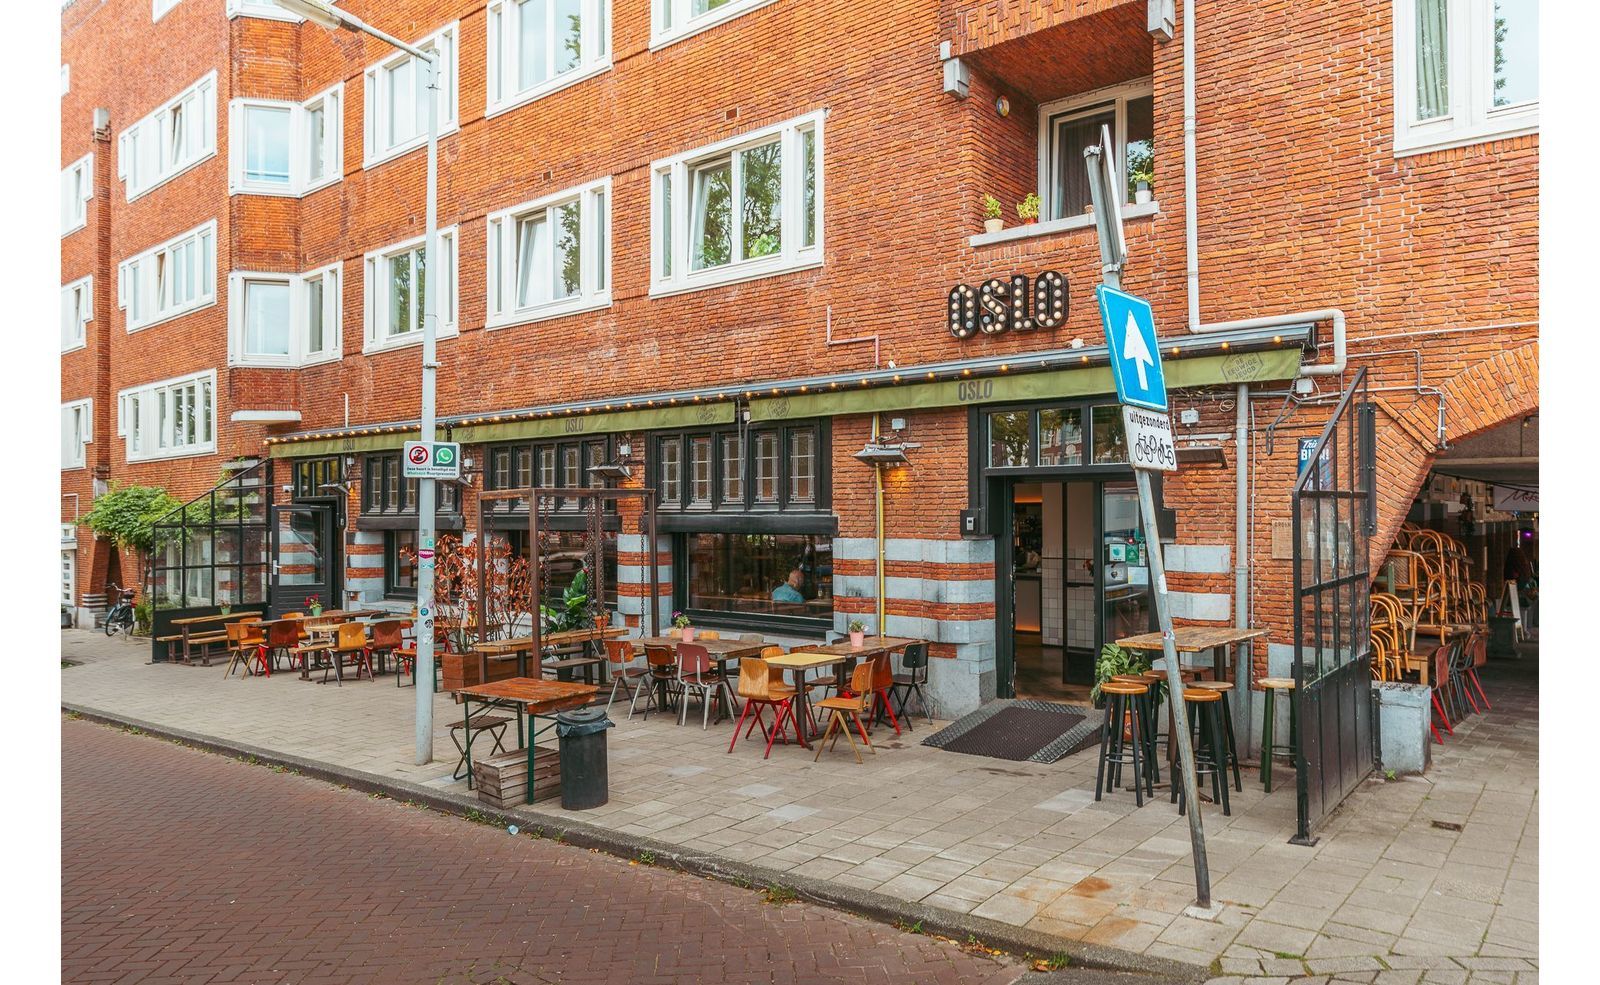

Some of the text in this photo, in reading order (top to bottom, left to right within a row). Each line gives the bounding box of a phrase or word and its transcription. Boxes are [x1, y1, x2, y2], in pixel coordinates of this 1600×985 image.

[948, 270, 1070, 338] OSLO
[959, 379, 993, 401] OSLO
[565, 418, 584, 432] OSLO
[1129, 411, 1170, 431] uitgezonderd
